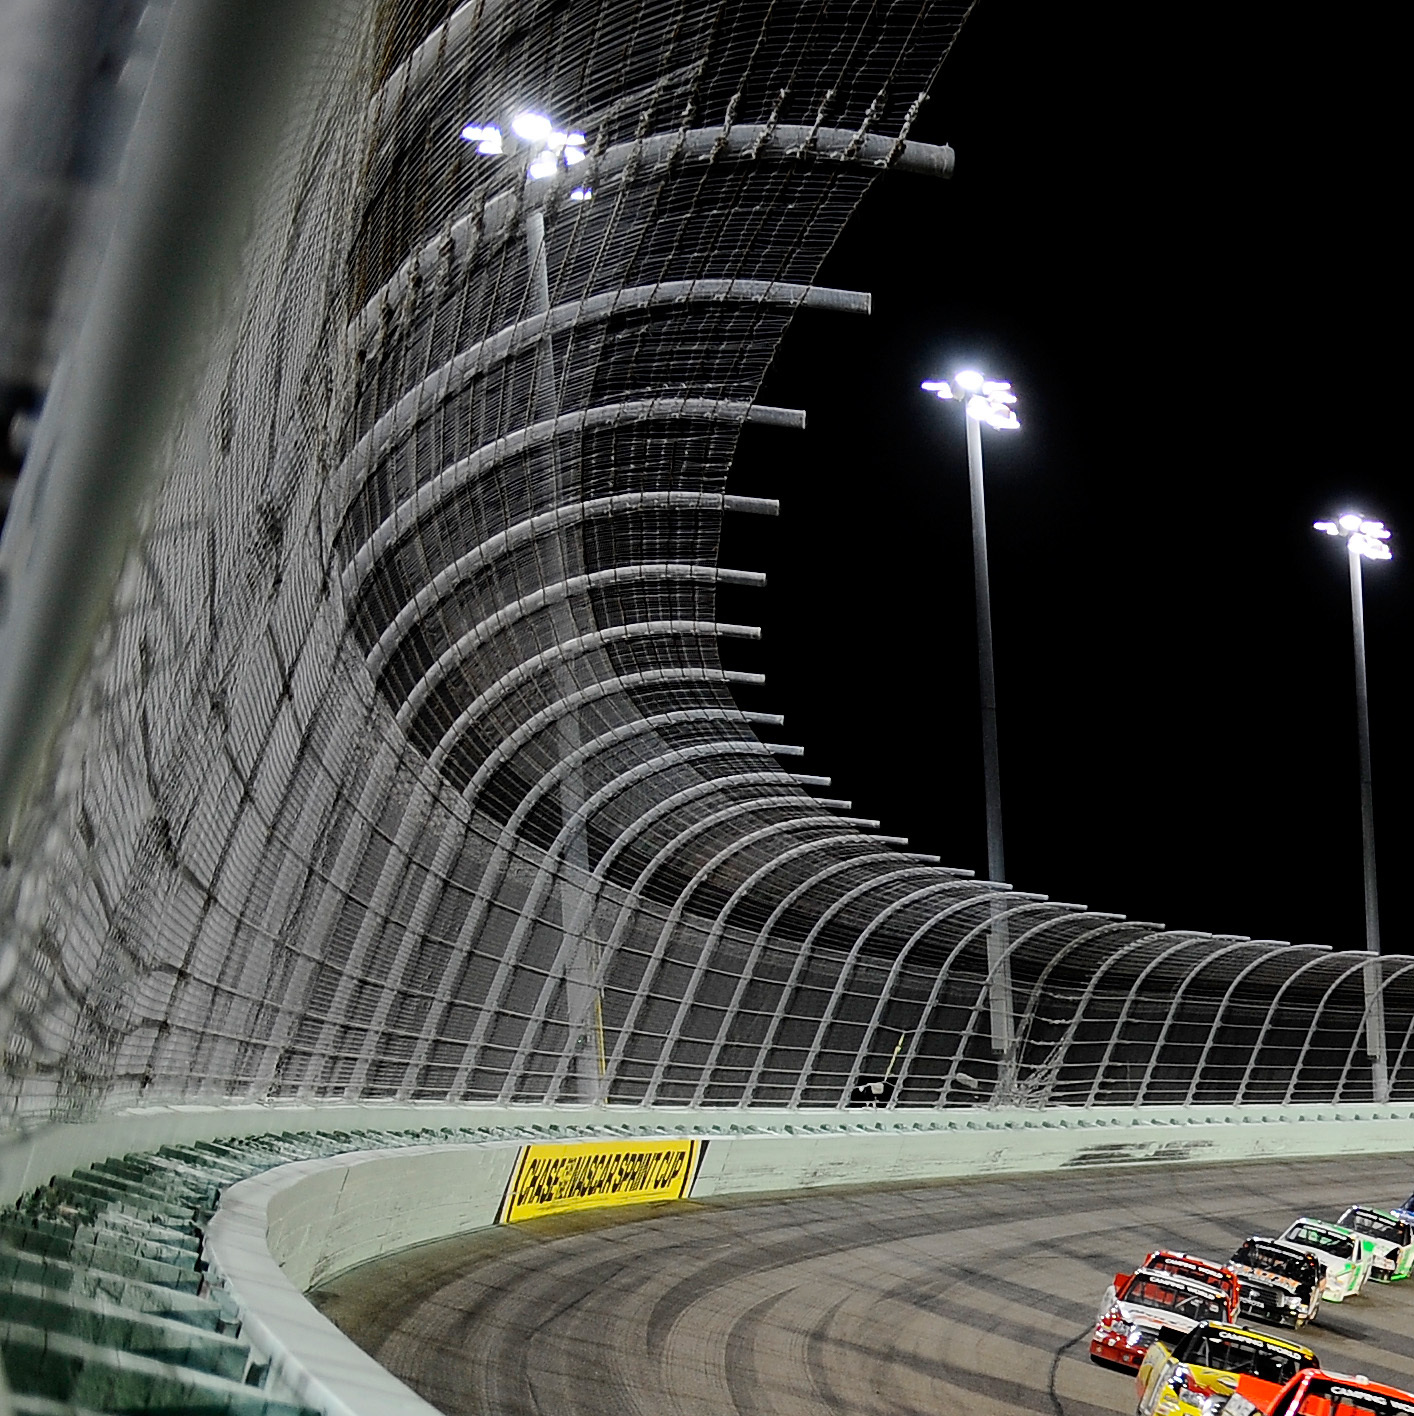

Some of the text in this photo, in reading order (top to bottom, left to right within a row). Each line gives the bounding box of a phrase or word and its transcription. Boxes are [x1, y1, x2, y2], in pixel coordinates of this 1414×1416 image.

[517, 1158, 568, 1206] CHASE
[566, 1153, 622, 1199] NASCAR
[612, 1152, 663, 1194] SPRINT
[653, 1151, 687, 1190] CUP
[1187, 1285, 1216, 1300] WORLD
[1219, 1331, 1302, 1360] CAMPING WORLD
[1330, 1386, 1388, 1406] CAMPING
